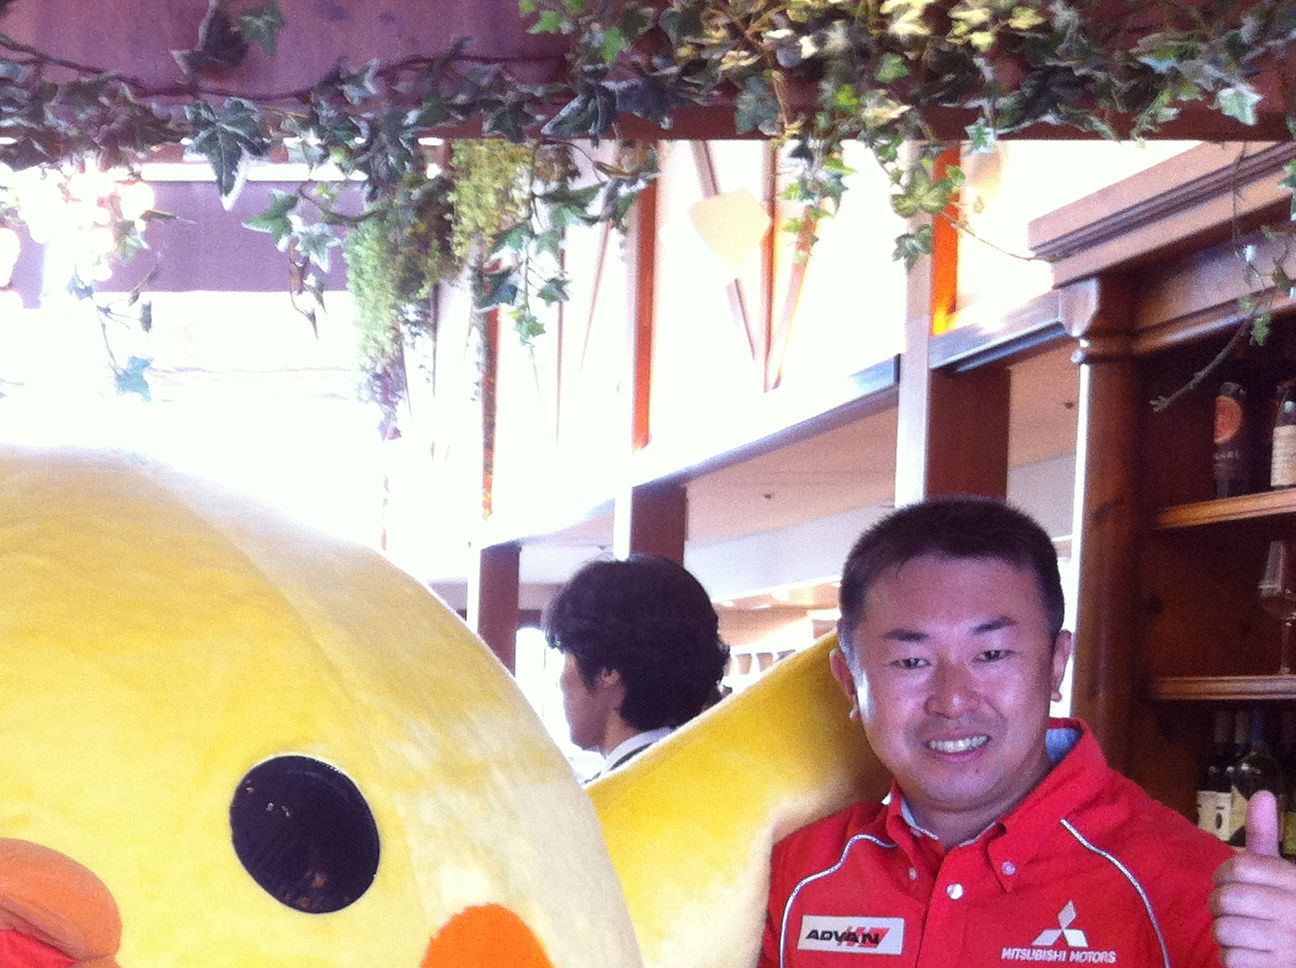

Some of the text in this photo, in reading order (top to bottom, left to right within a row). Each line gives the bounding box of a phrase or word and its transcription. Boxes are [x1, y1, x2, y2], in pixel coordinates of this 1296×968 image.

[805, 929, 882, 945] ADVAN
[1001, 947, 1117, 964] MITSUBISHI MOTORS
